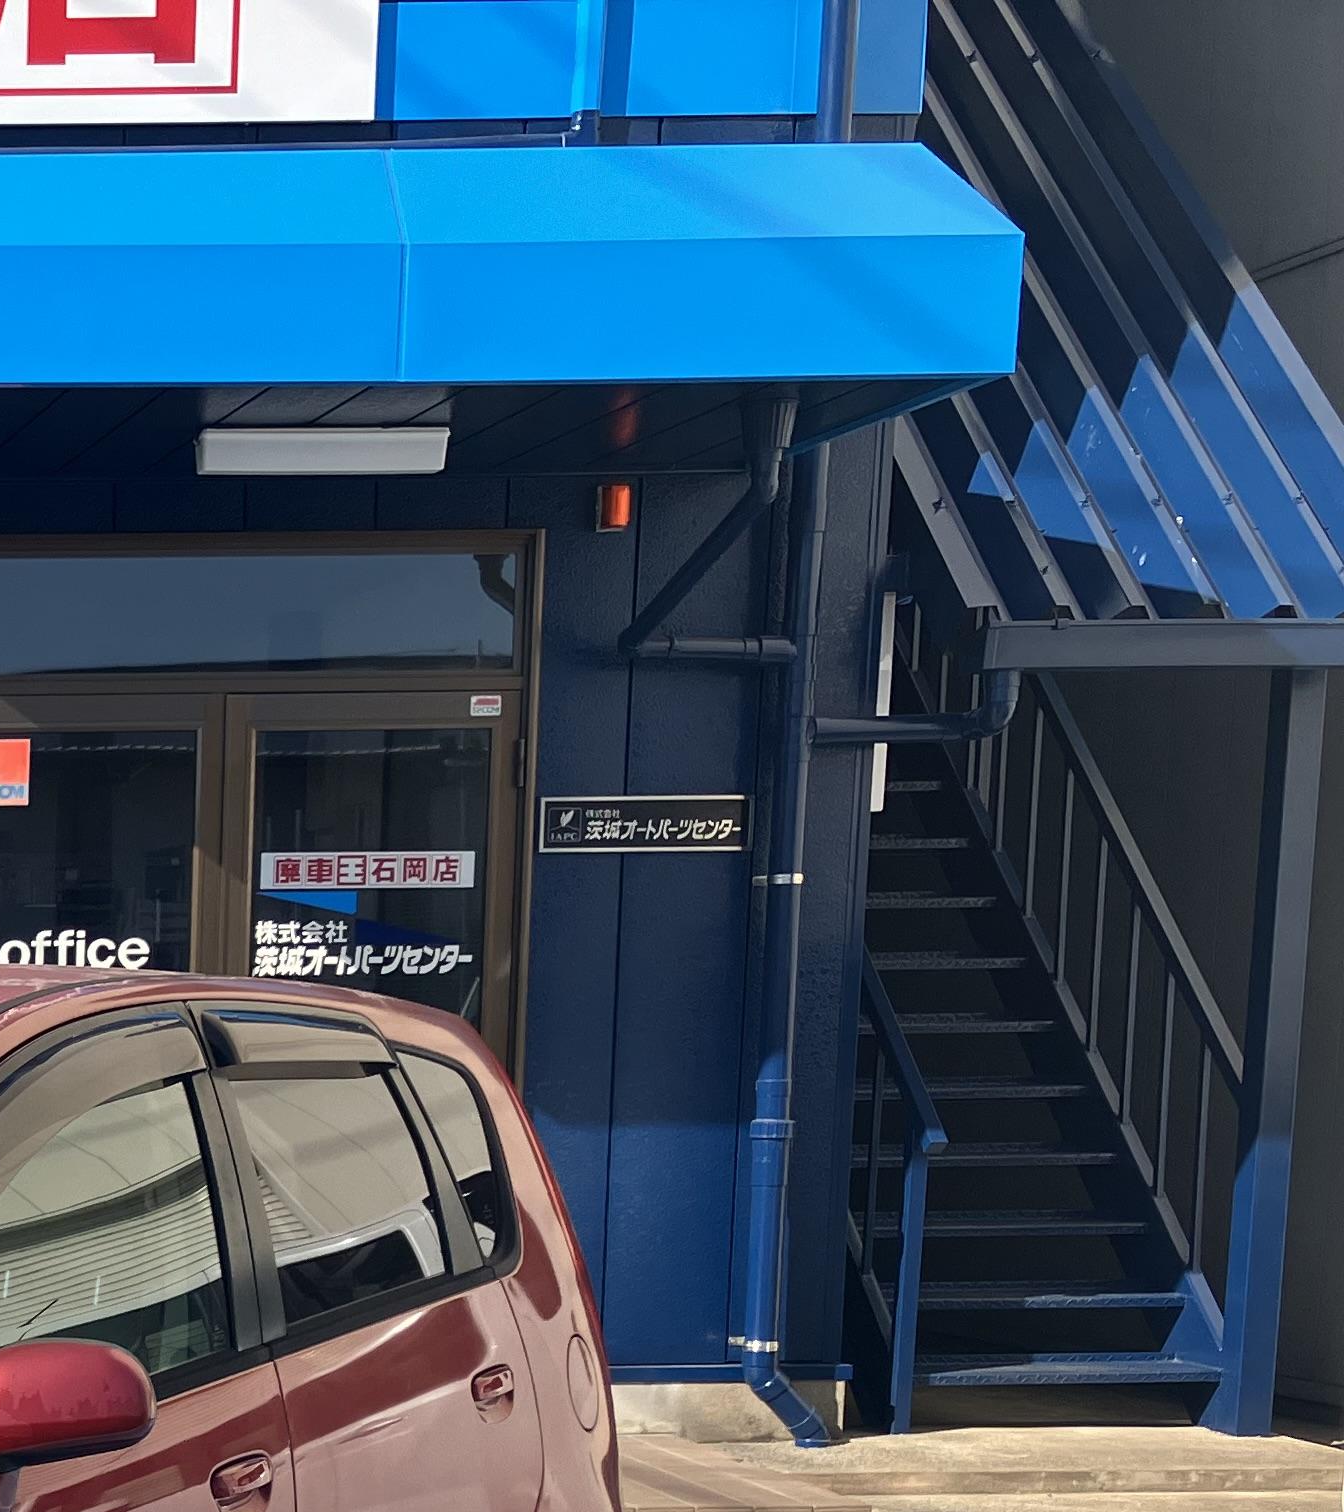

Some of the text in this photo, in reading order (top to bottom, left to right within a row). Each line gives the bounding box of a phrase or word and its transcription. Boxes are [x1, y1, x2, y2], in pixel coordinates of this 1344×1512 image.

[584, 819, 742, 840] 茨城オートパーツセンター
[274, 855, 460, 885] 廃車王石岡店
[255, 919, 349, 945] 株式会社
[0, 929, 151, 970] office
[252, 944, 473, 978] 茨城オートパーツセンター
